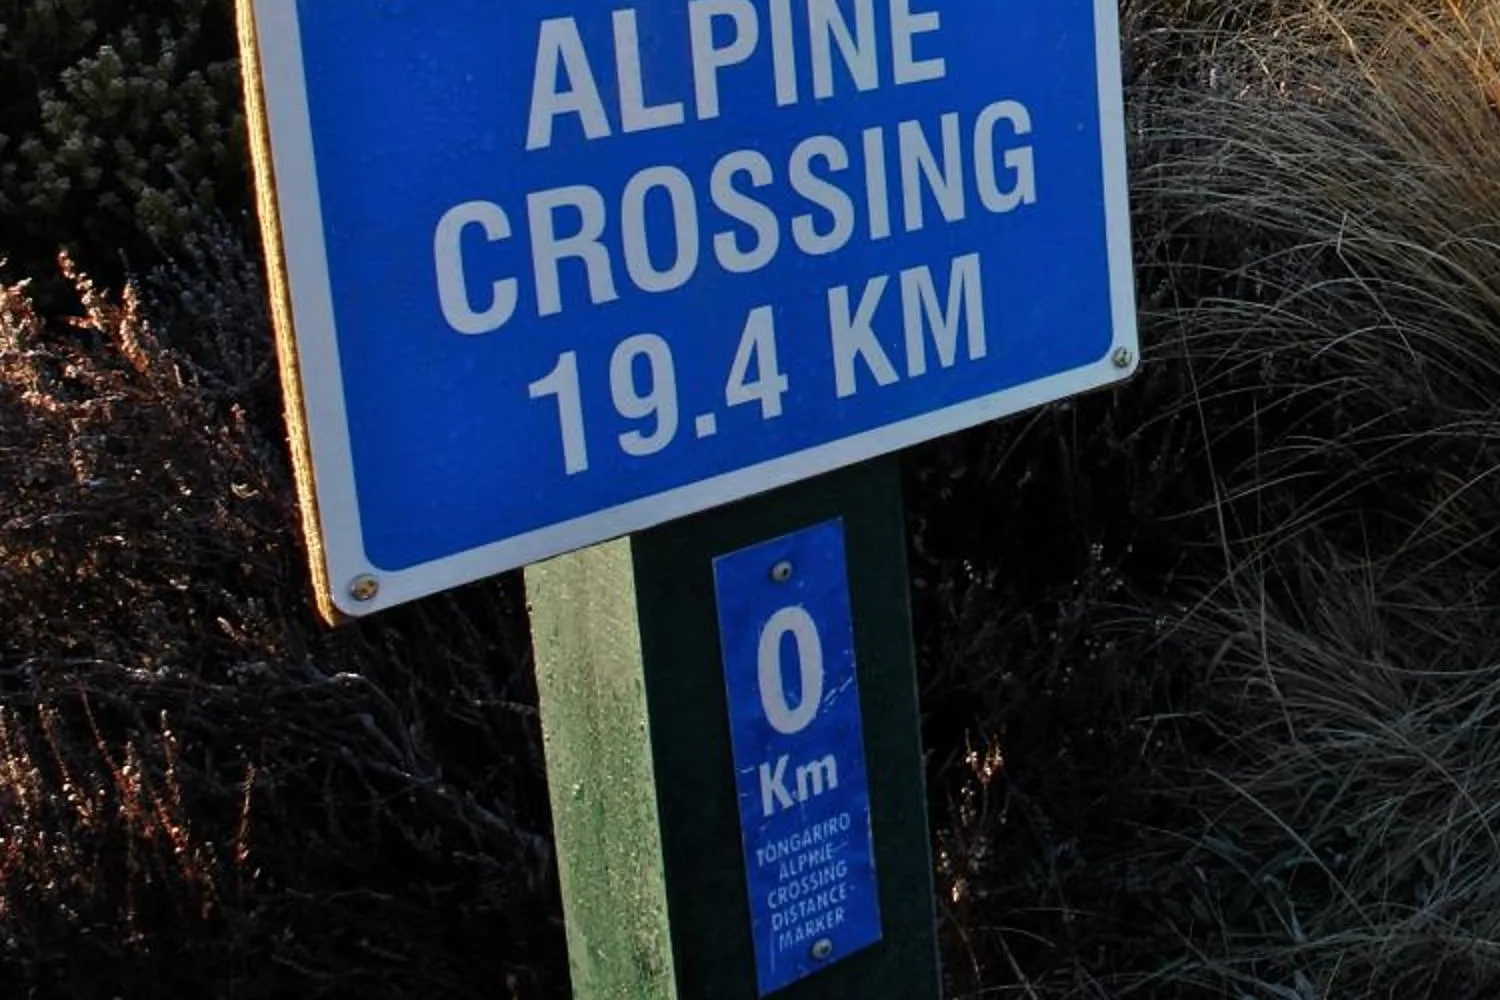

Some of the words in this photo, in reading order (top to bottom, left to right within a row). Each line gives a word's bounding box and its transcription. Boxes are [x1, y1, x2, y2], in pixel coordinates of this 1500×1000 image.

[433, 99, 1037, 335] CROSSING
[529, 306, 788, 476] 19.4
[827, 252, 988, 398] KM
[758, 606, 823, 734] 0
[758, 753, 838, 817] Km
[755, 812, 851, 868] TONGARIRO
[767, 860, 848, 909] CROSSING
[771, 882, 847, 932] DISTANCE
[778, 906, 845, 953] MARKER
